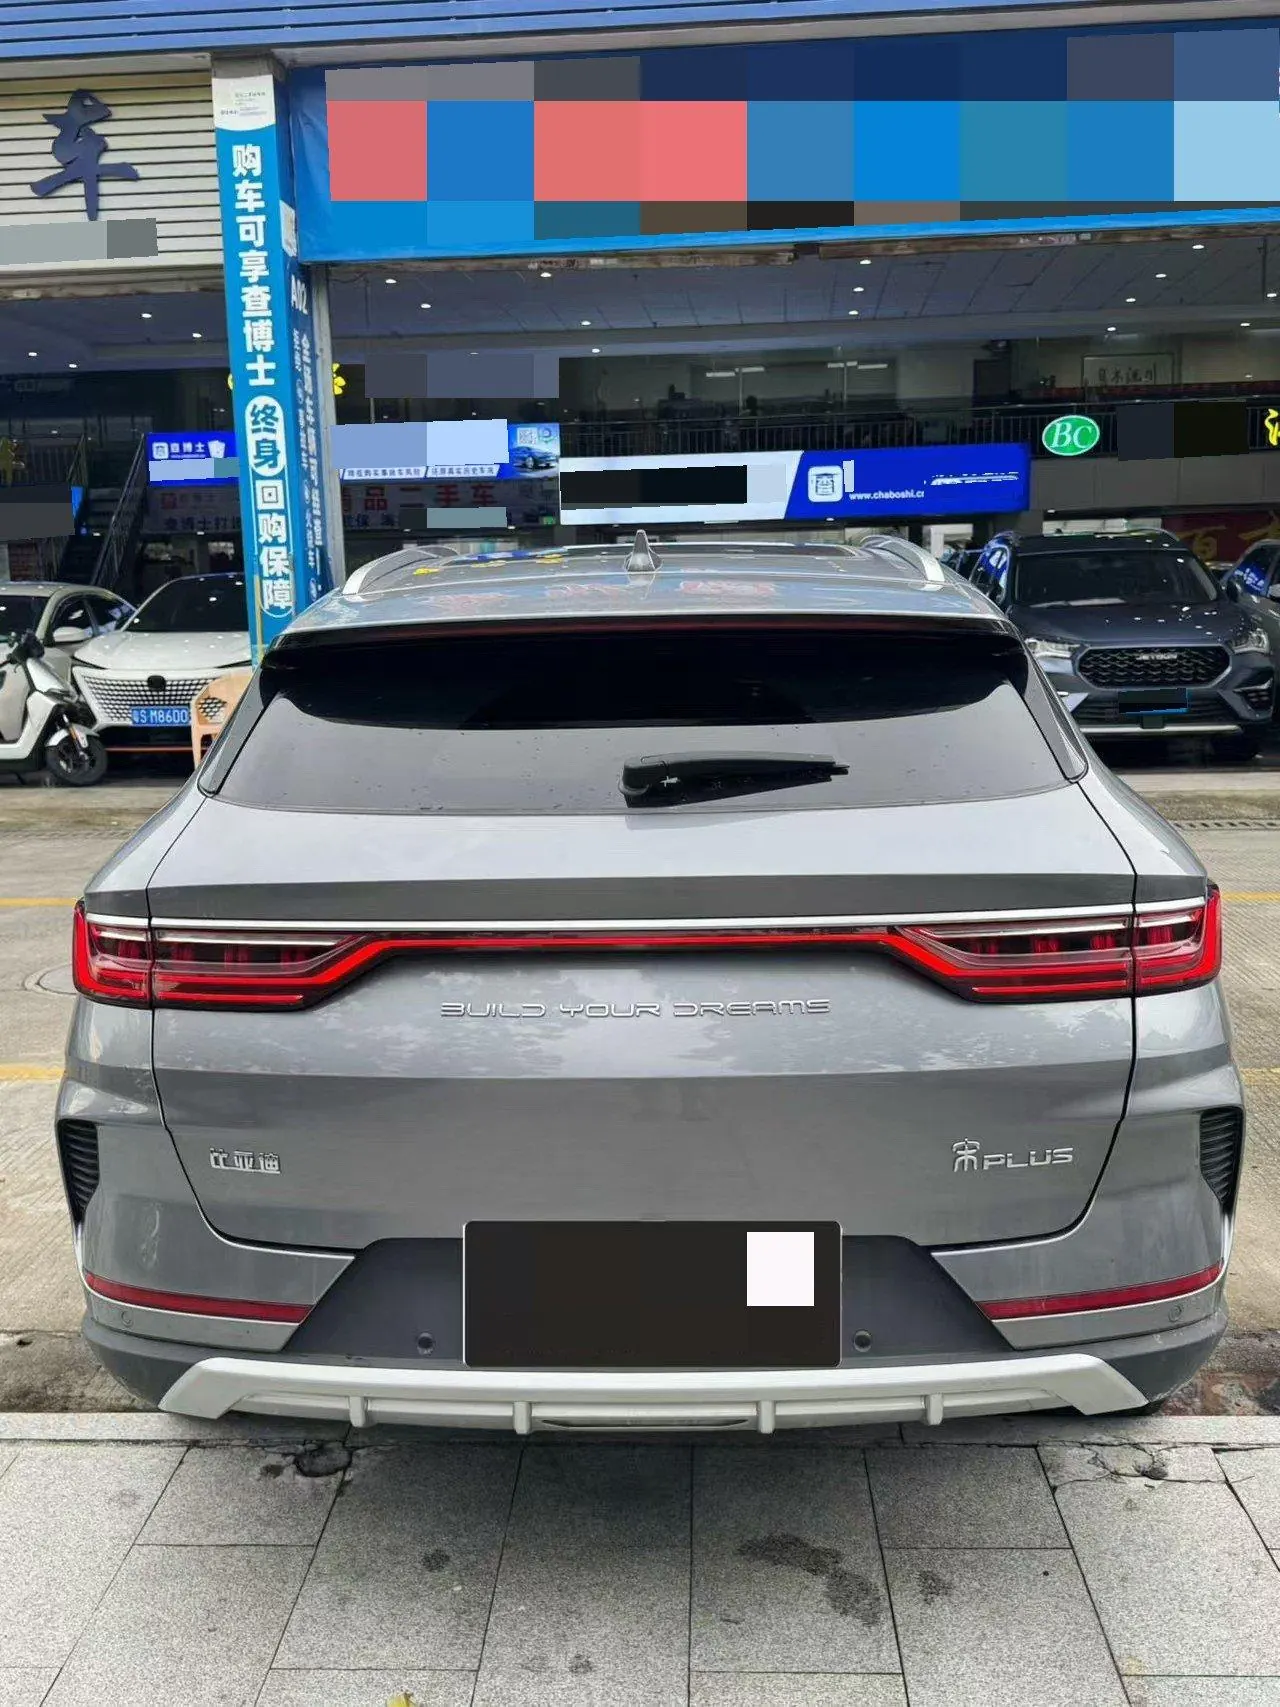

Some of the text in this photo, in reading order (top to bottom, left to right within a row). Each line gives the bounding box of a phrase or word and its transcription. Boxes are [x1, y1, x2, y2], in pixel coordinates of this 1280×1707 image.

[232, 143, 277, 386] 购车可享查博士
[1050, 421, 1092, 449] BC
[440, 999, 831, 1018] BUILD YOUR DREAMS
[209, 1147, 281, 1174] 比亚迪
